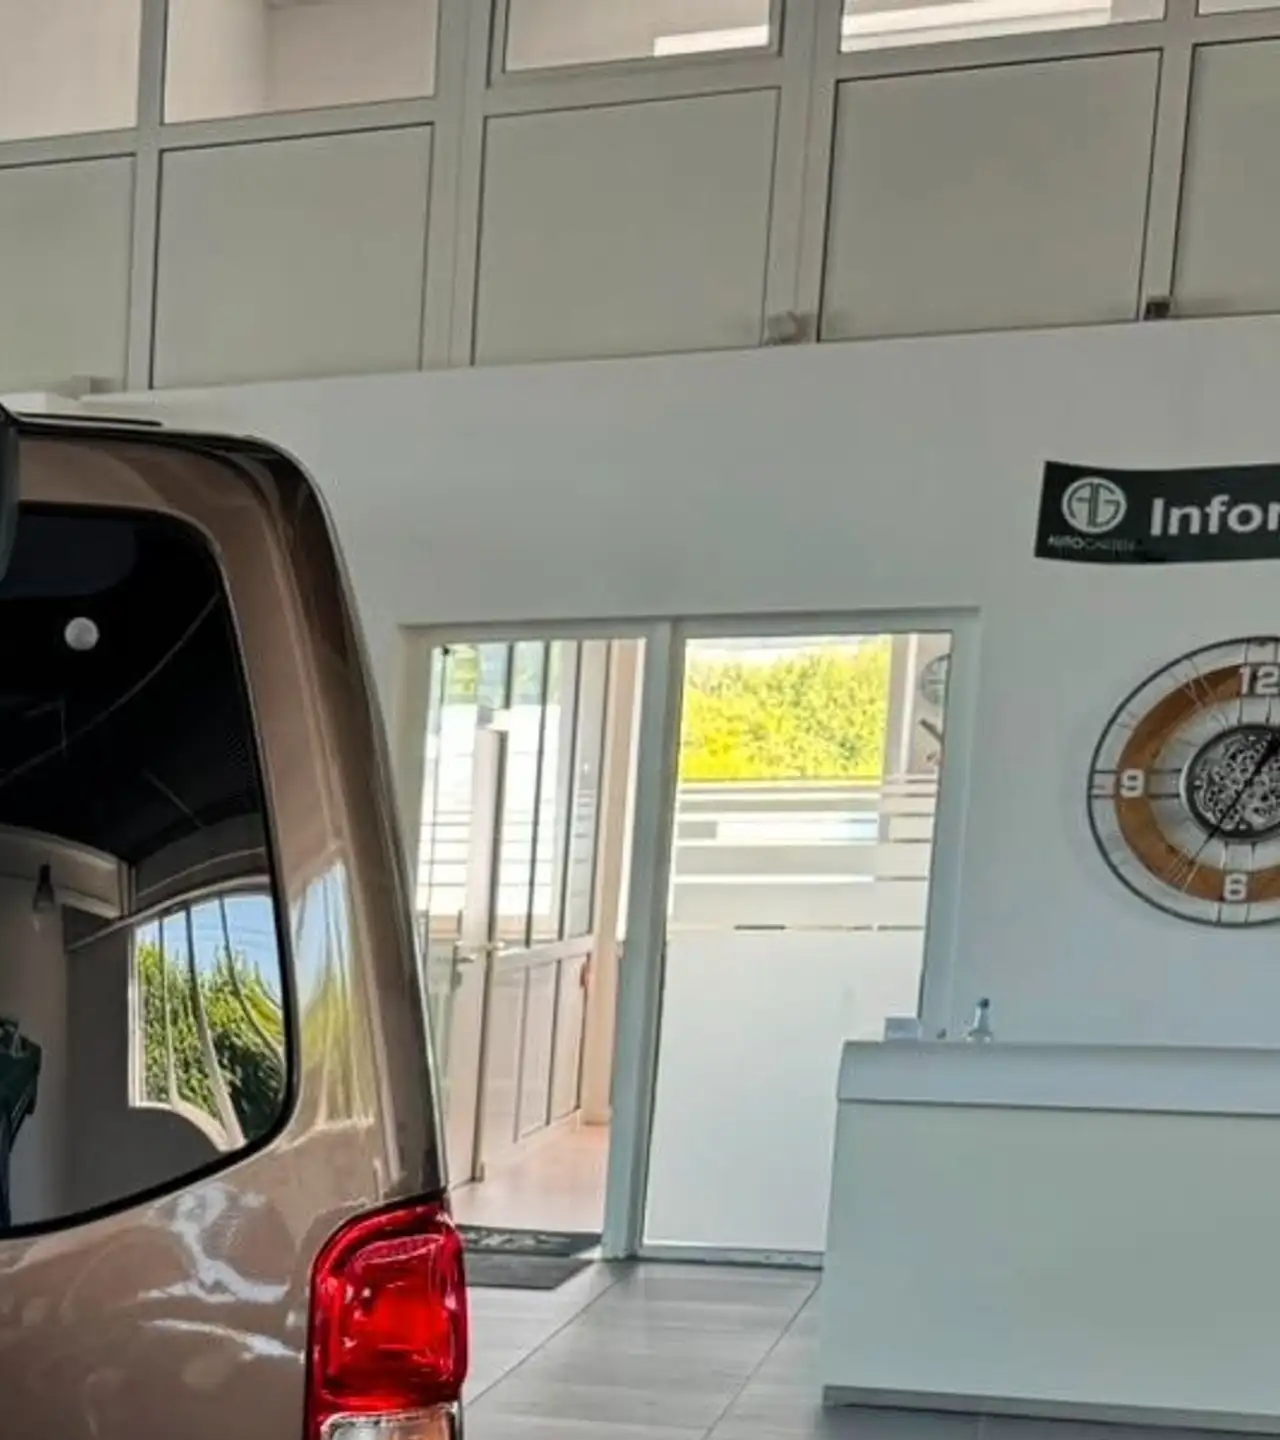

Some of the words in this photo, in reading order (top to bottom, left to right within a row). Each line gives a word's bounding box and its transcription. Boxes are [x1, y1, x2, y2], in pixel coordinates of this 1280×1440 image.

[1239, 665, 1280, 696] 12
[1120, 768, 1145, 799] 9
[1222, 872, 1249, 901] 6
